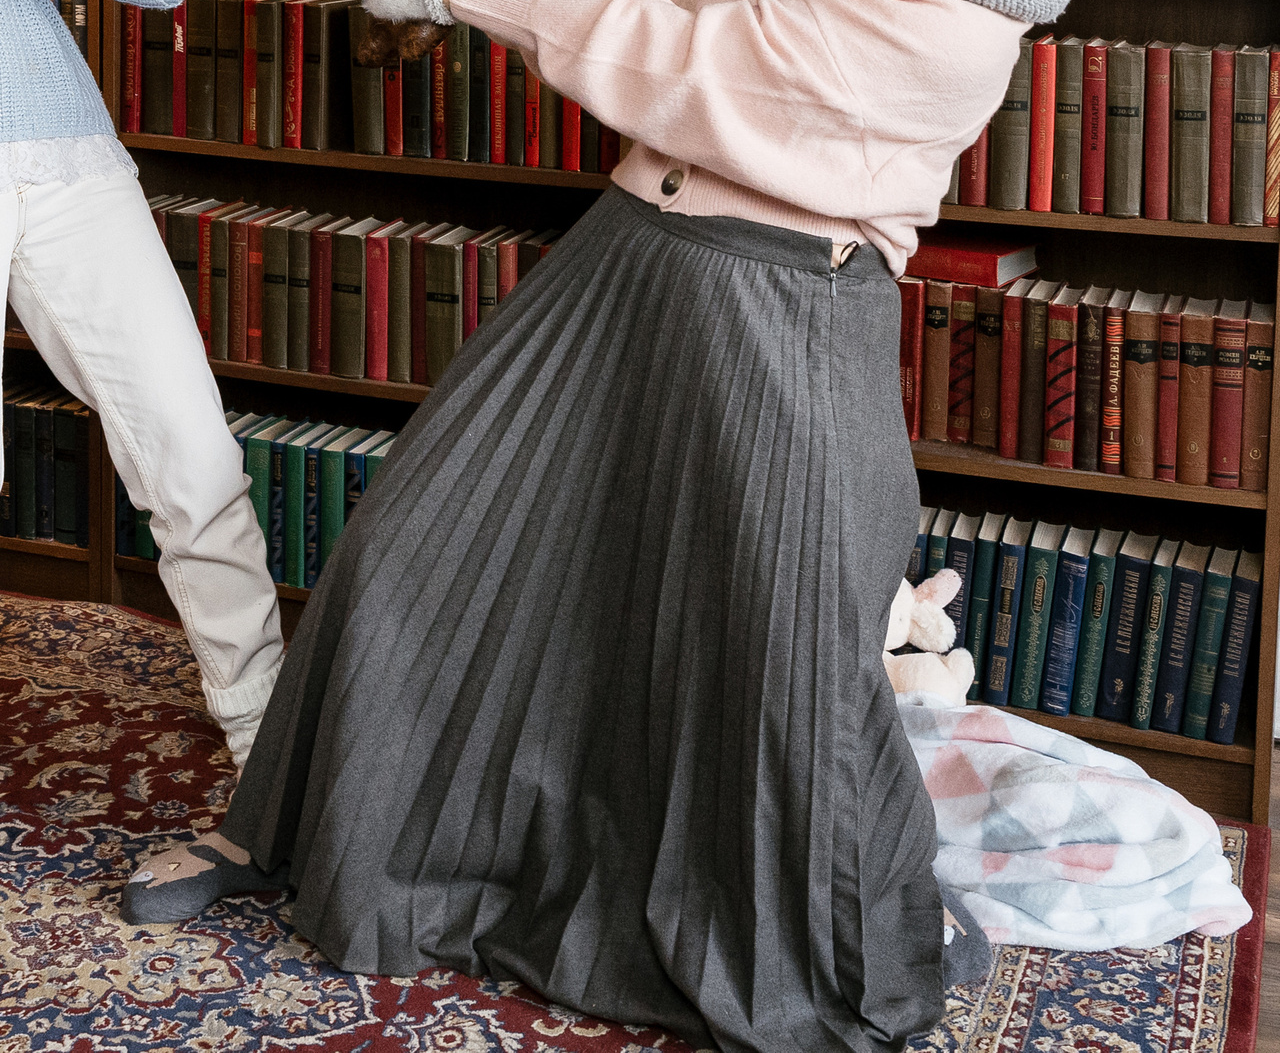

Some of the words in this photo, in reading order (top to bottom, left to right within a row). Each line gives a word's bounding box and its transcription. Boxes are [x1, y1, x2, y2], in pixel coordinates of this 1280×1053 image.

[232, 245, 243, 301] ШОЛОХОВ
[1108, 345, 1121, 395] ФАДЕЕВ
[1109, 430, 1114, 441] 1
[1116, 569, 1141, 639] МЕРЕЖКОВСКИЙ
[1170, 581, 1195, 652] МЕРЕЖКОВСКИЙ
[1224, 590, 1251, 662] МЕРЕЖКОВСКИЙ
